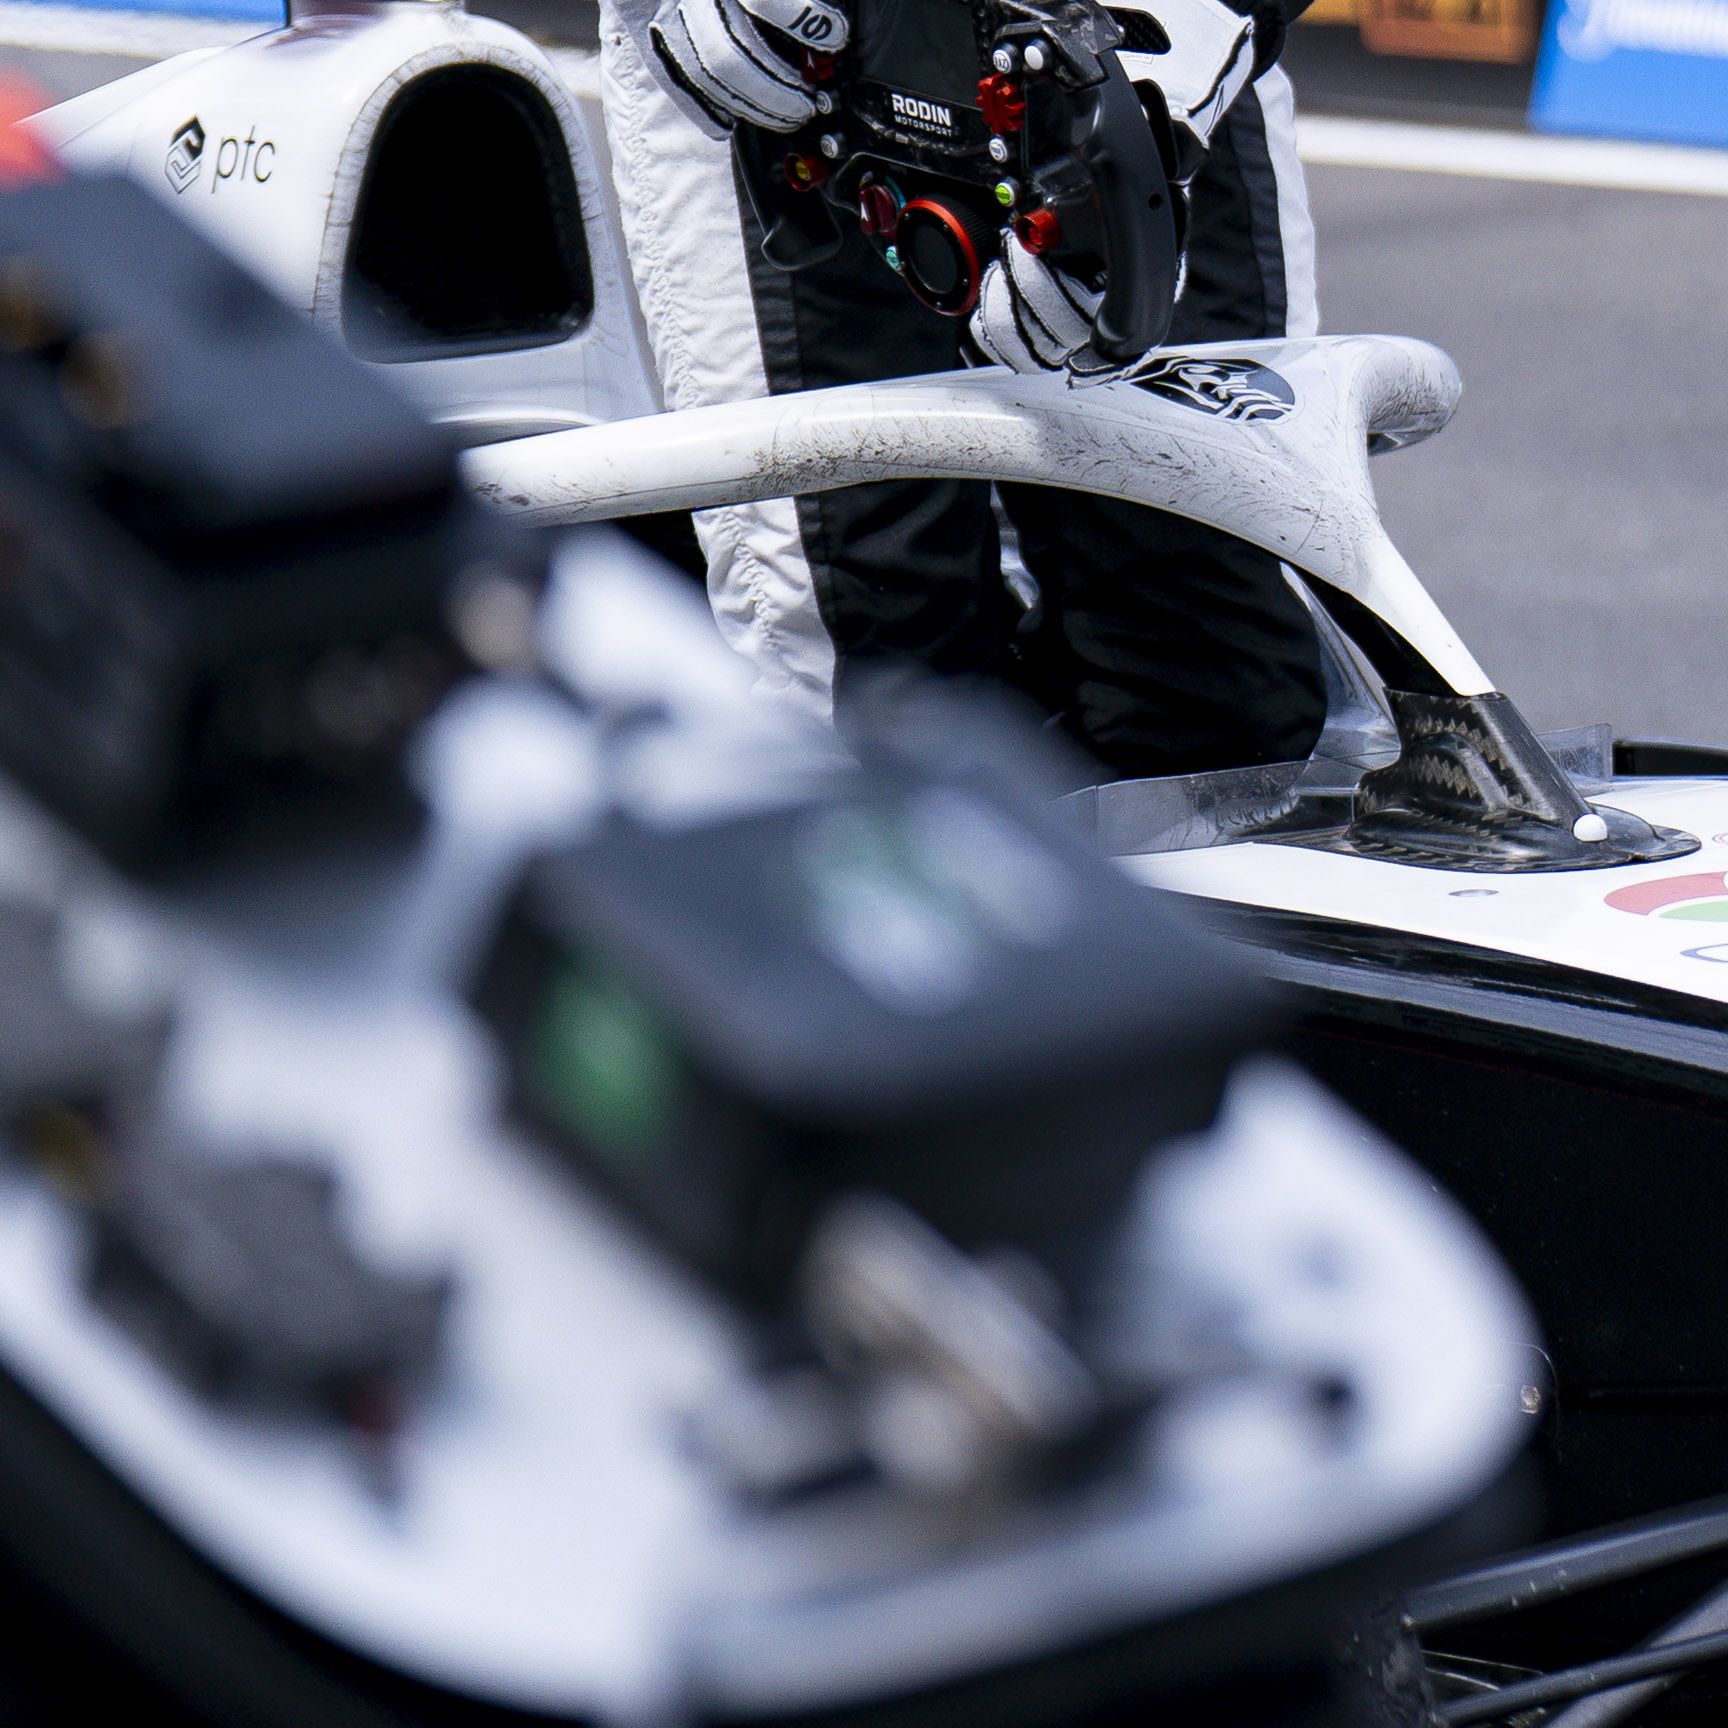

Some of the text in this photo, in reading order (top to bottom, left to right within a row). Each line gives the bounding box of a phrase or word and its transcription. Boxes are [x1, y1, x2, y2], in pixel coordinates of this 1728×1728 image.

[891, 93, 952, 127] RODIN
[894, 114, 952, 138] MOTORSPORT
[211, 126, 277, 194] ptc
